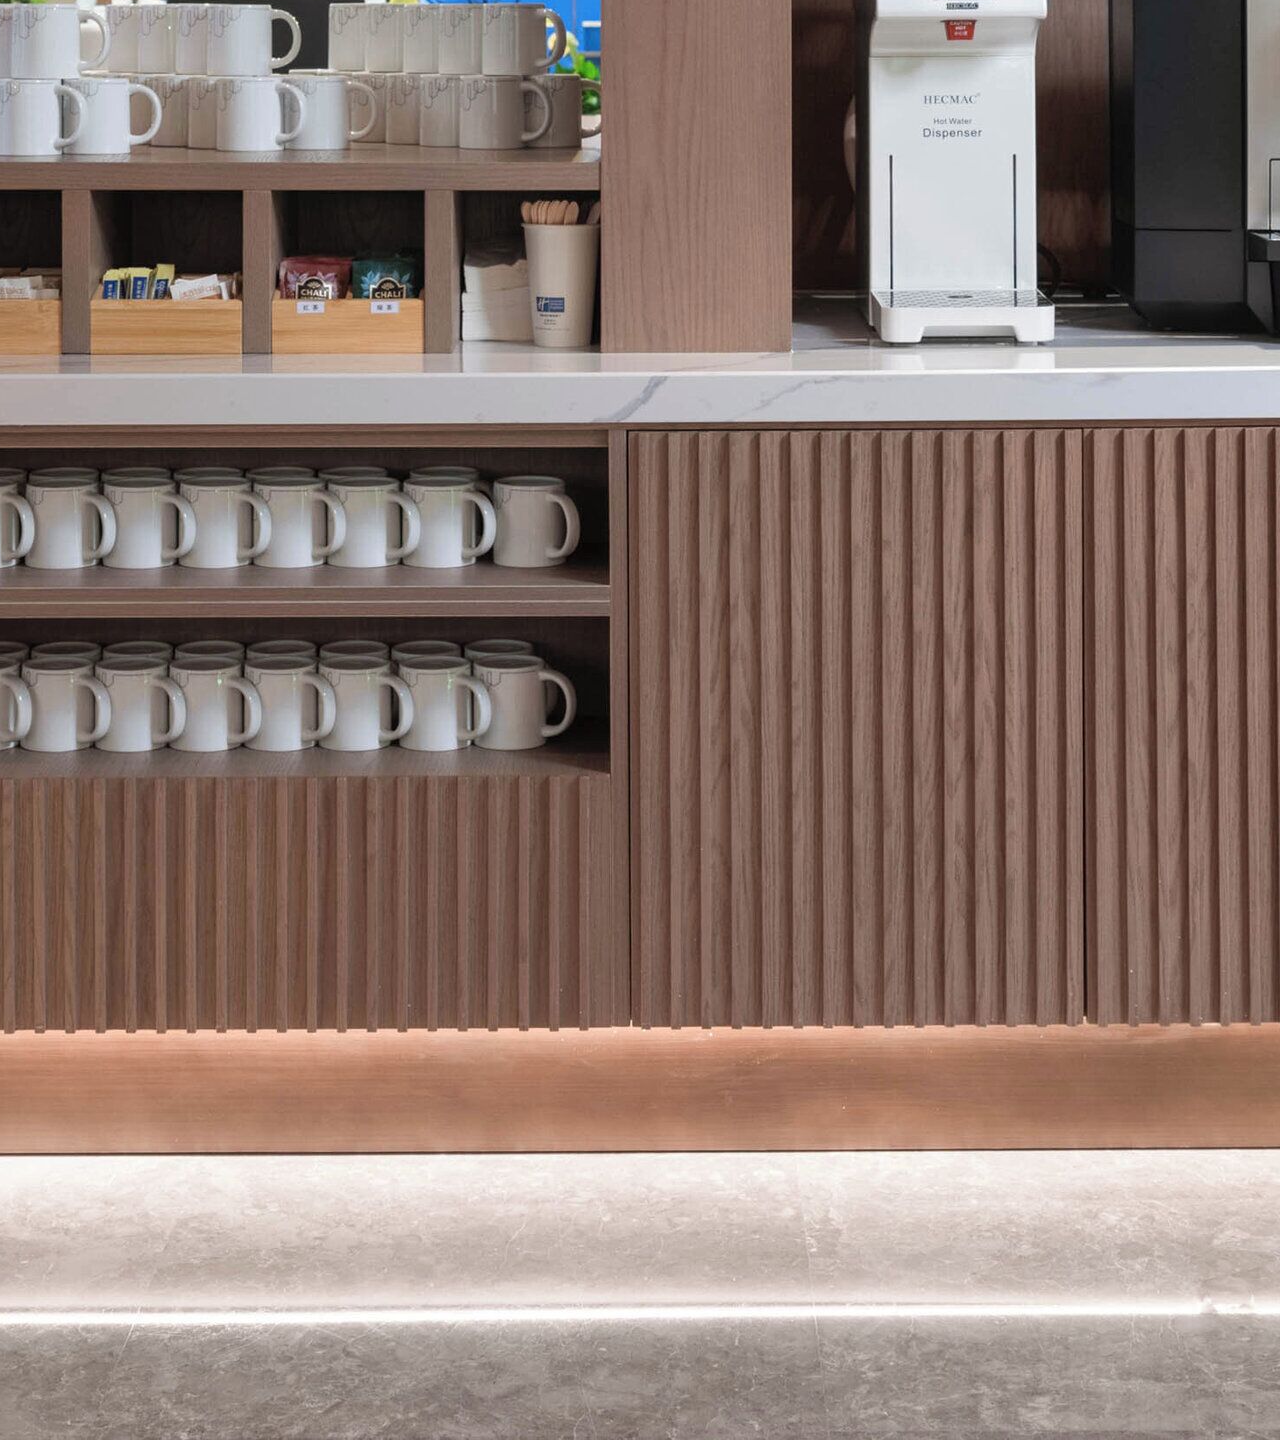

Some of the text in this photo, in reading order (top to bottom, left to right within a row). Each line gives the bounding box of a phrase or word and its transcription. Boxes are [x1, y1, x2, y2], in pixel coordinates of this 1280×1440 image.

[924, 95, 977, 105] HECMAC
[933, 117, 973, 125] Hot Water
[923, 128, 983, 140] Dispenser
[300, 288, 327, 298] CHALI
[374, 290, 401, 299] CHALI
